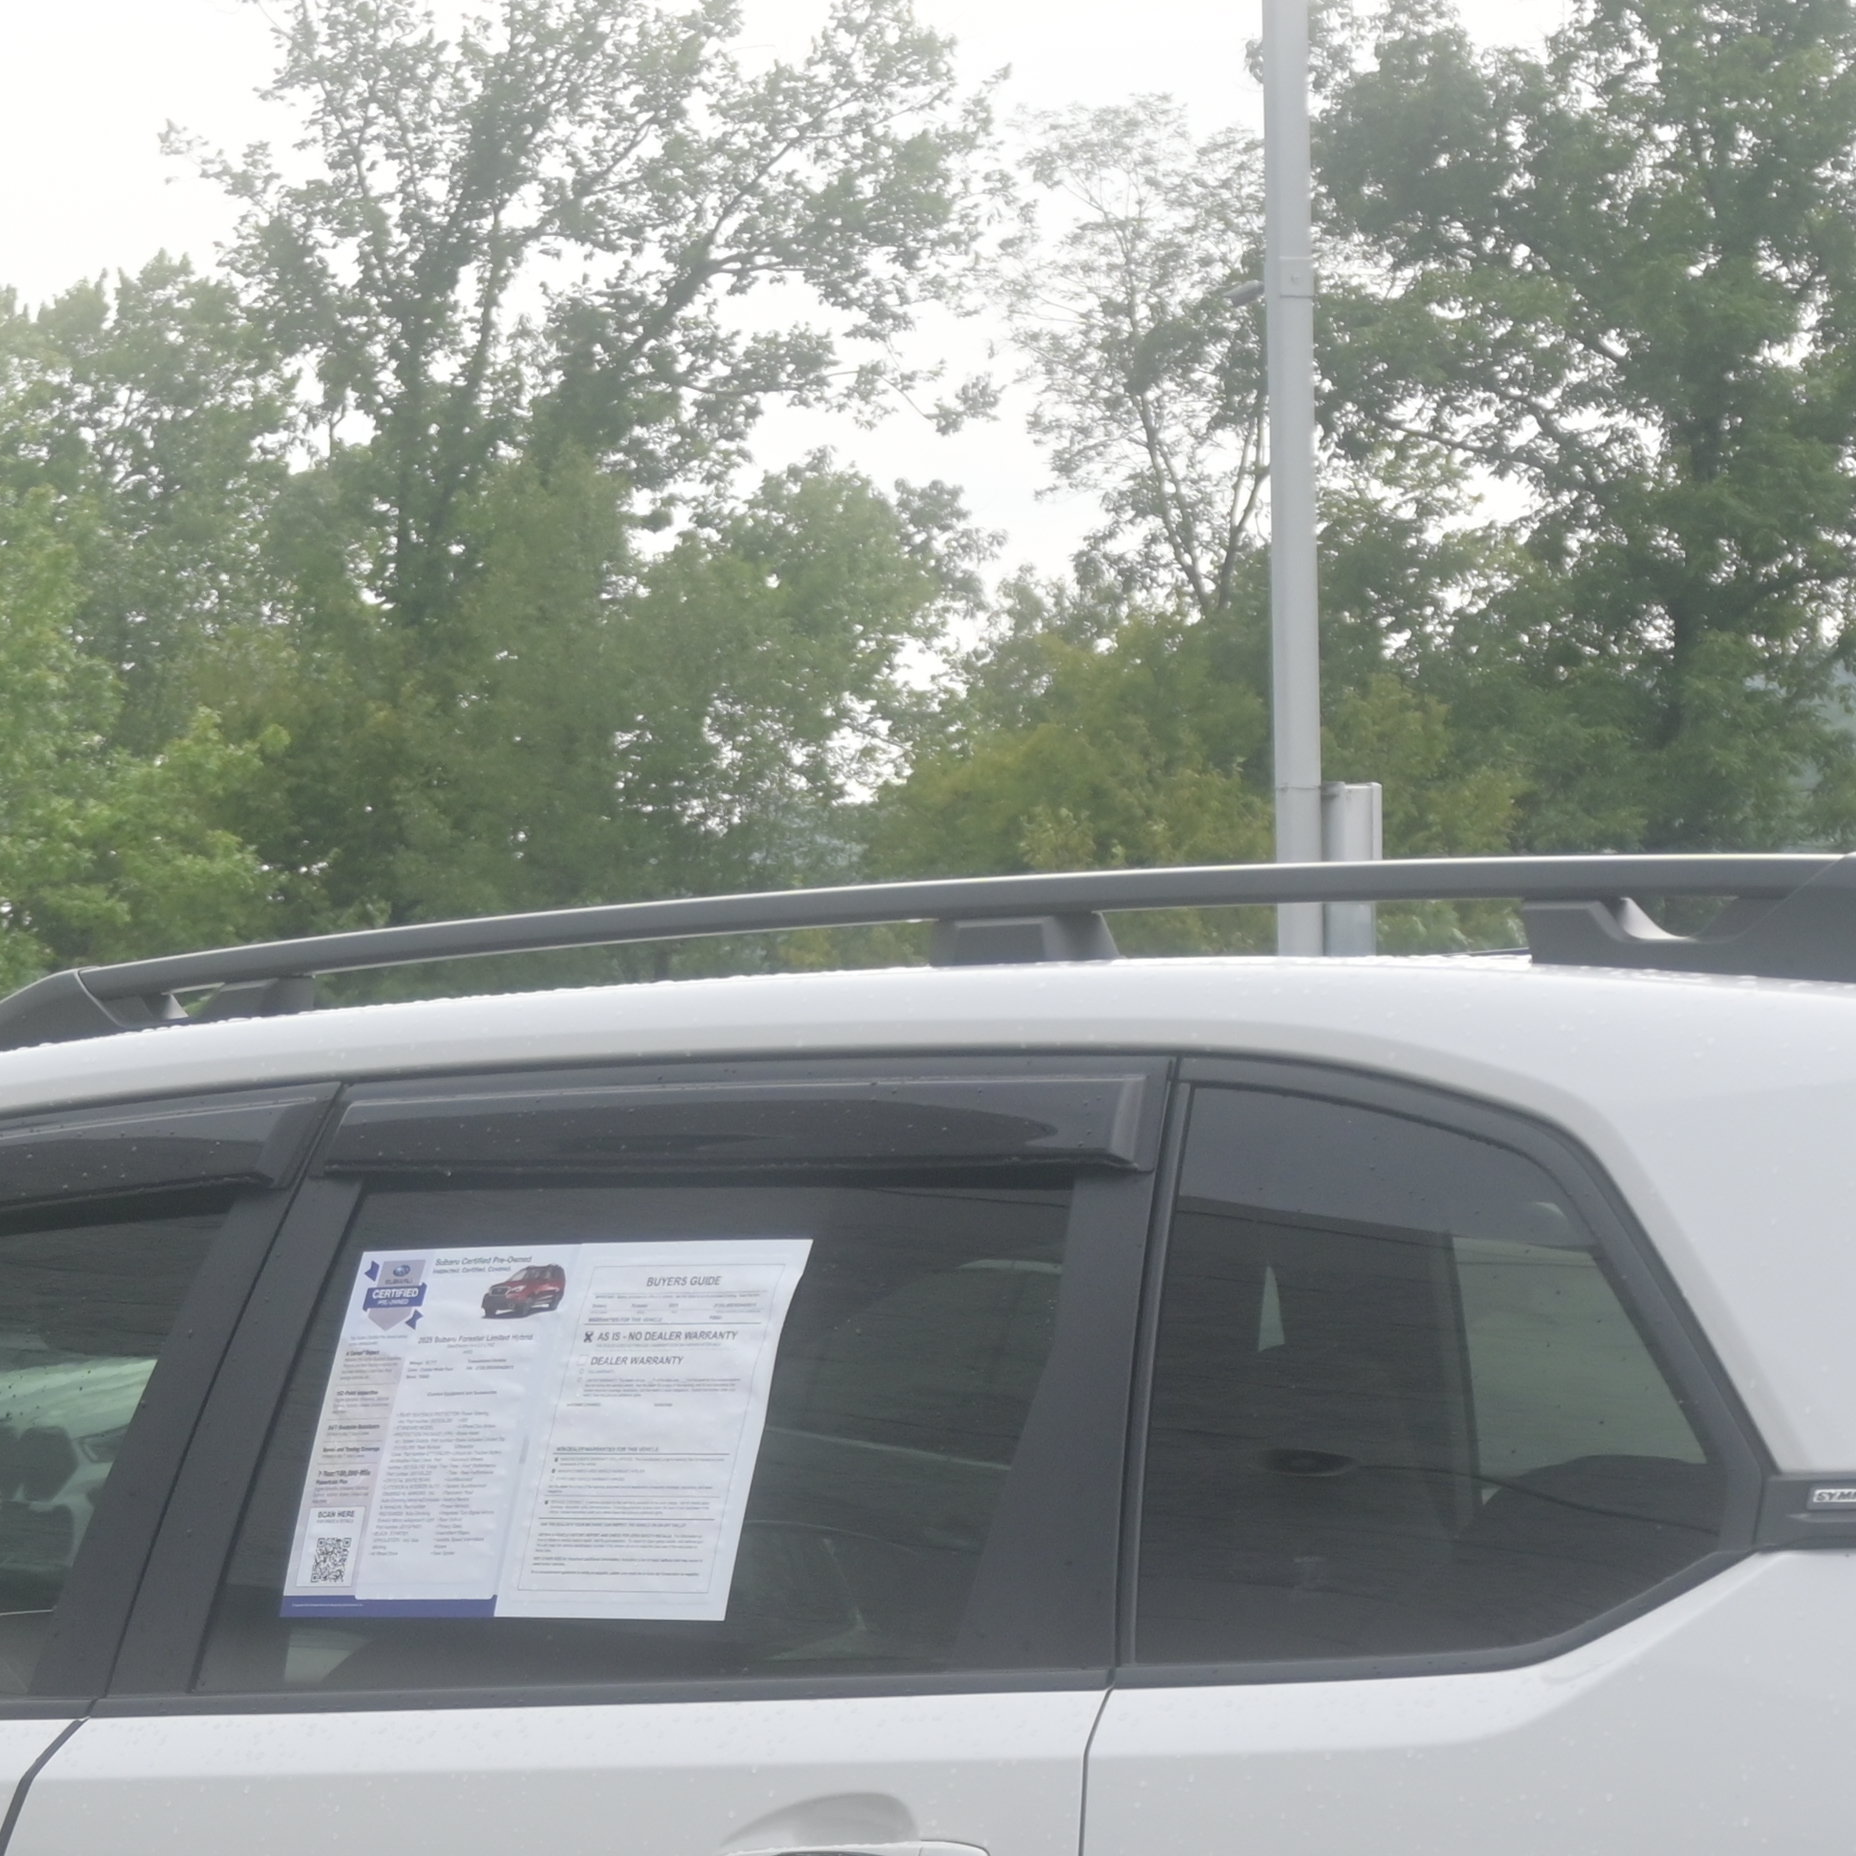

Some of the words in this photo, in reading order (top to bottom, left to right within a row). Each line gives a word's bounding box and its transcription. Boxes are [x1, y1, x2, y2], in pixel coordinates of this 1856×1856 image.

[646, 1276, 688, 1287] BUYERS
[690, 1276, 721, 1286] GUIDE
[372, 1288, 418, 1299] CERTIFIED
[597, 1332, 610, 1342] AS
[611, 1332, 621, 1341] IS
[628, 1332, 643, 1341] NO
[644, 1332, 682, 1341] DEALER
[684, 1331, 738, 1341] WARRANTY
[590, 1356, 628, 1366] DEALER
[630, 1356, 683, 1366] WARRANTY
